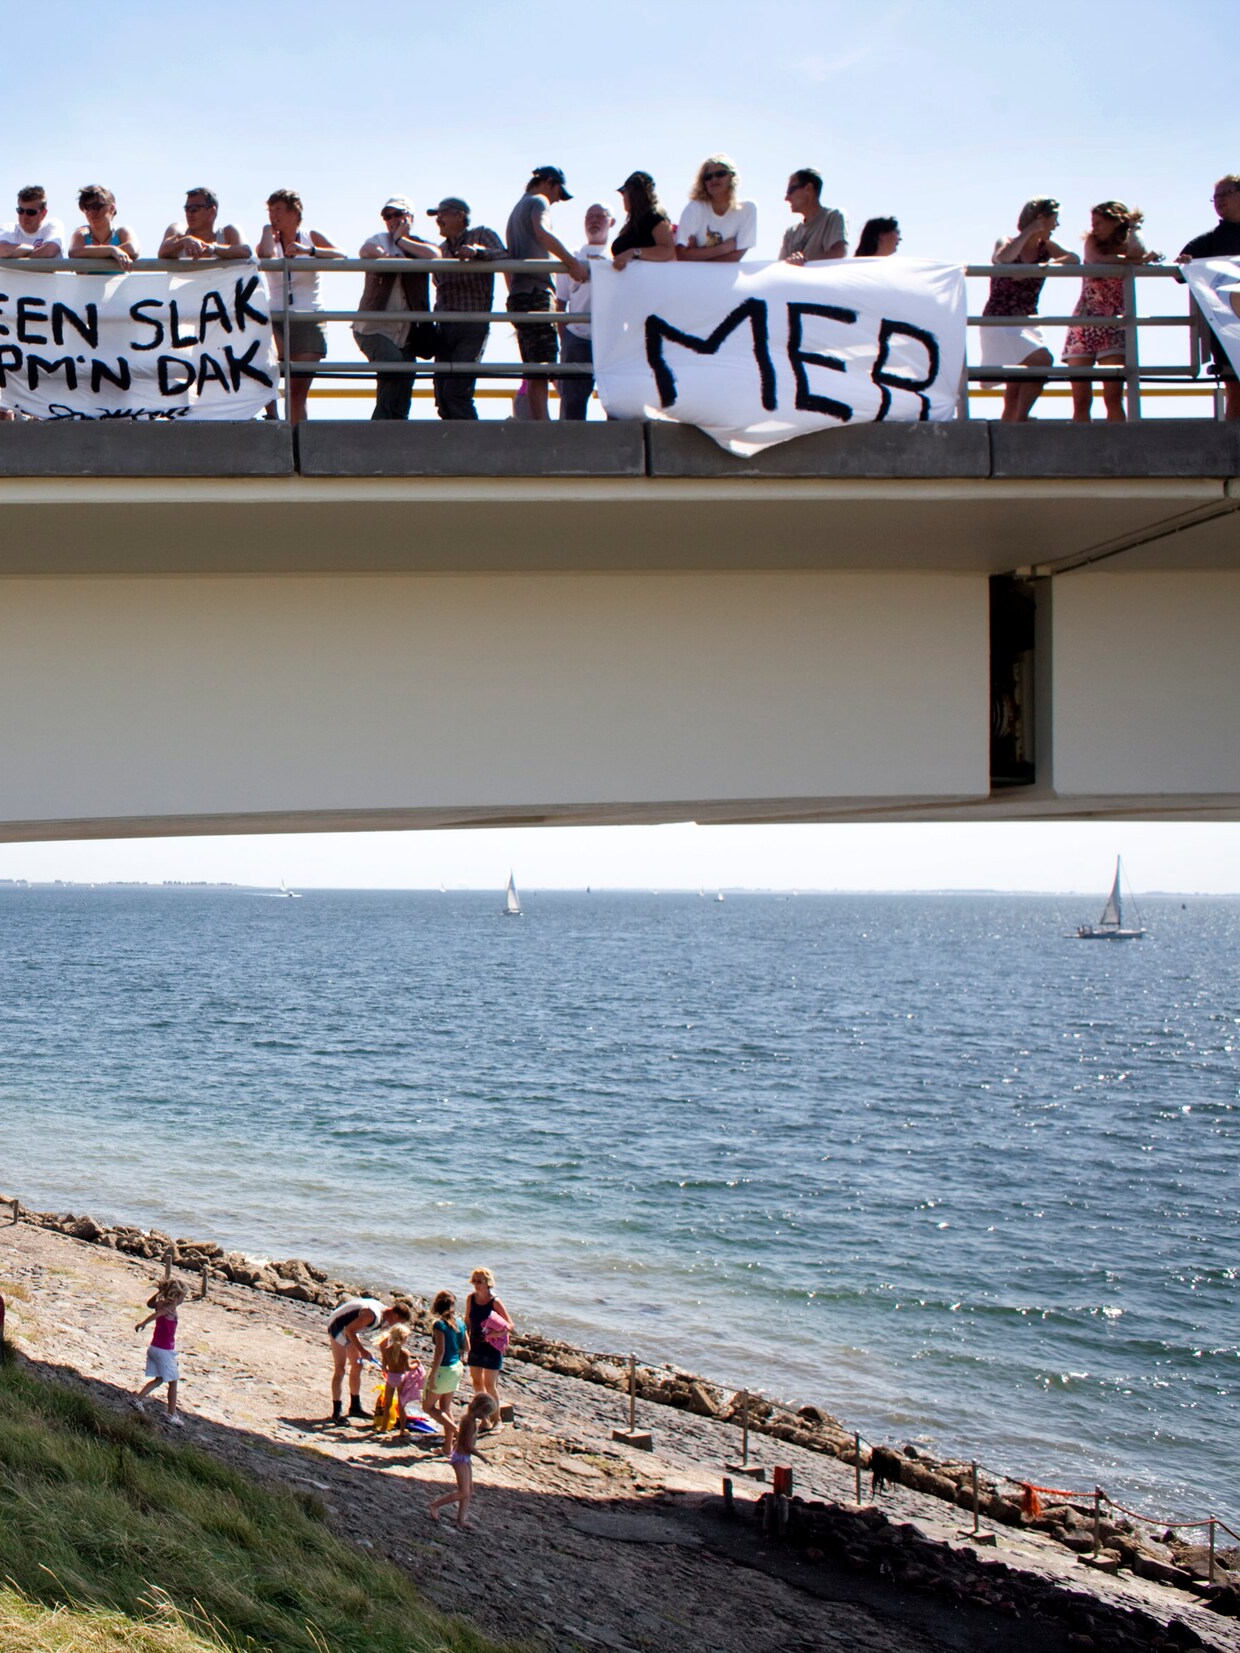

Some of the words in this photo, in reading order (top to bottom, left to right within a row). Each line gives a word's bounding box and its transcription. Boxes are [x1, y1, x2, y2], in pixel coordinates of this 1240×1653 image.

[129, 275, 268, 350] SLAK
[157, 340, 274, 396] DAK
[645, 297, 939, 421] MER
